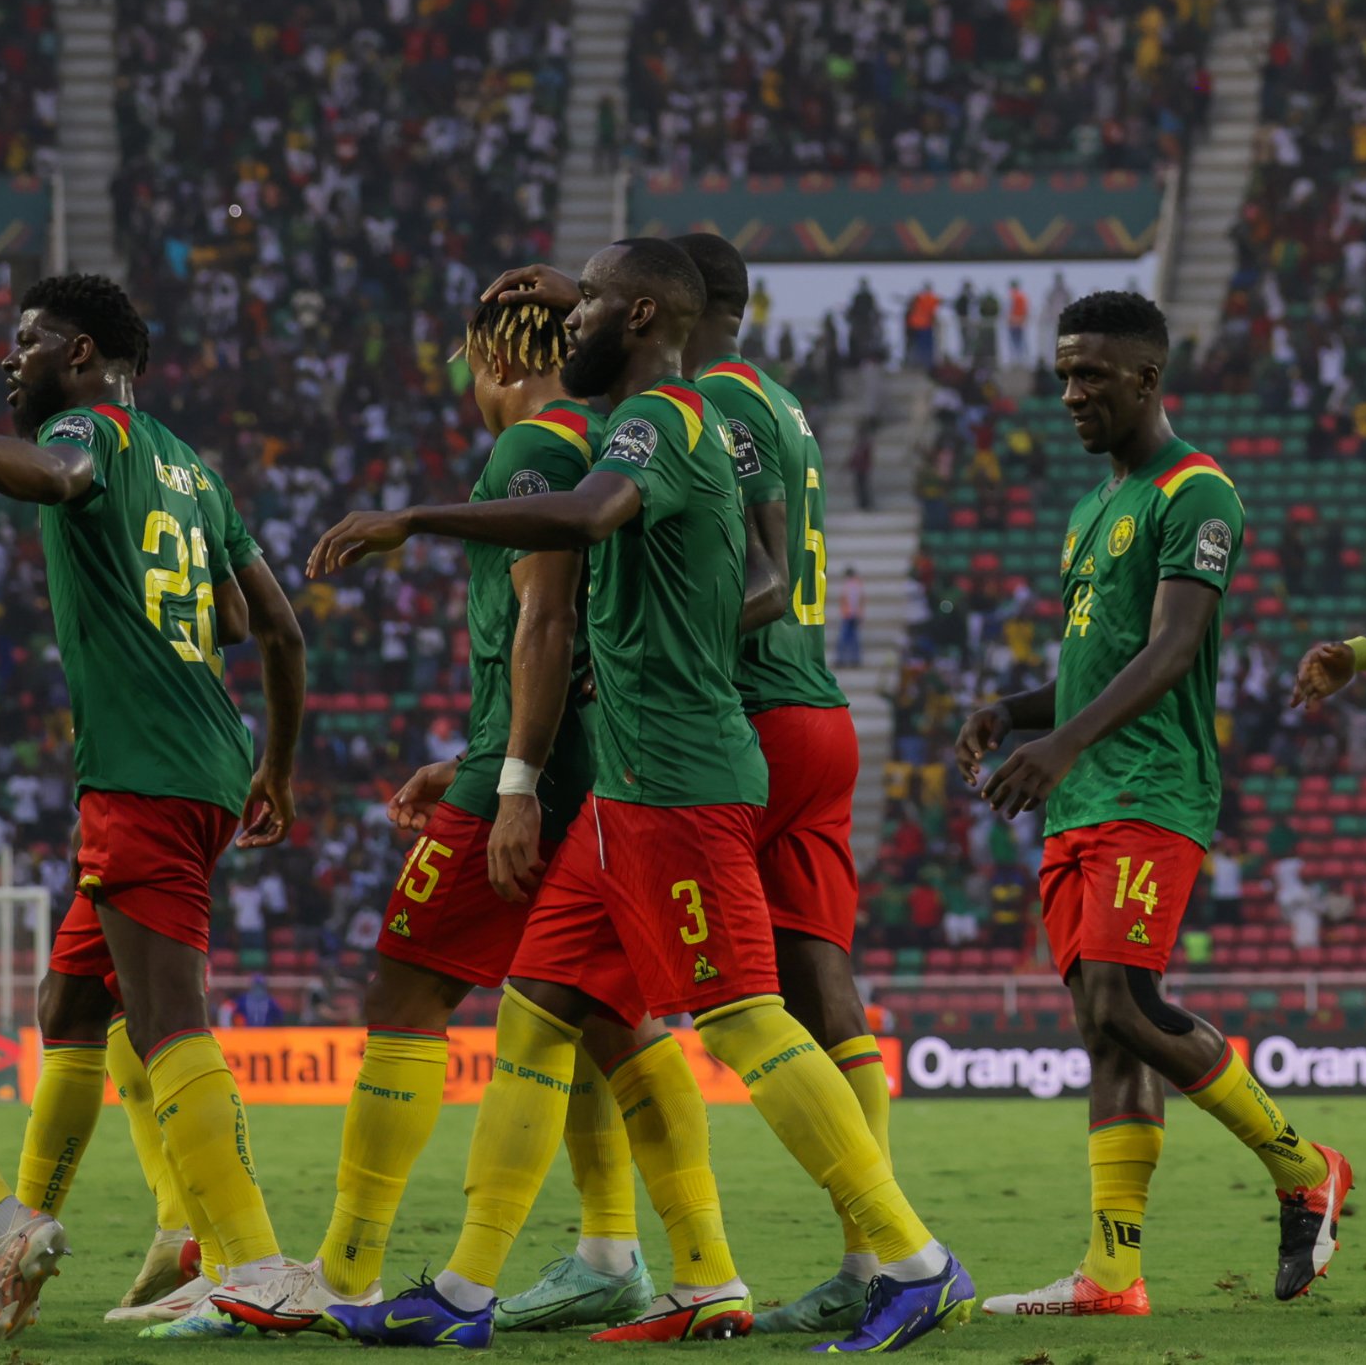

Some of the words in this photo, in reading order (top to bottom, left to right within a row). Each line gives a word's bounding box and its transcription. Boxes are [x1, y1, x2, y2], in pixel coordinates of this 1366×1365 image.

[1064, 583, 1094, 638] 14
[396, 835, 453, 903] 15
[1114, 856, 1159, 915] 14
[671, 879, 708, 945] 3
[227, 1041, 337, 1084] ental
[907, 1036, 1092, 1098] Orange
[41, 1137, 80, 1210] CAMEROUN
